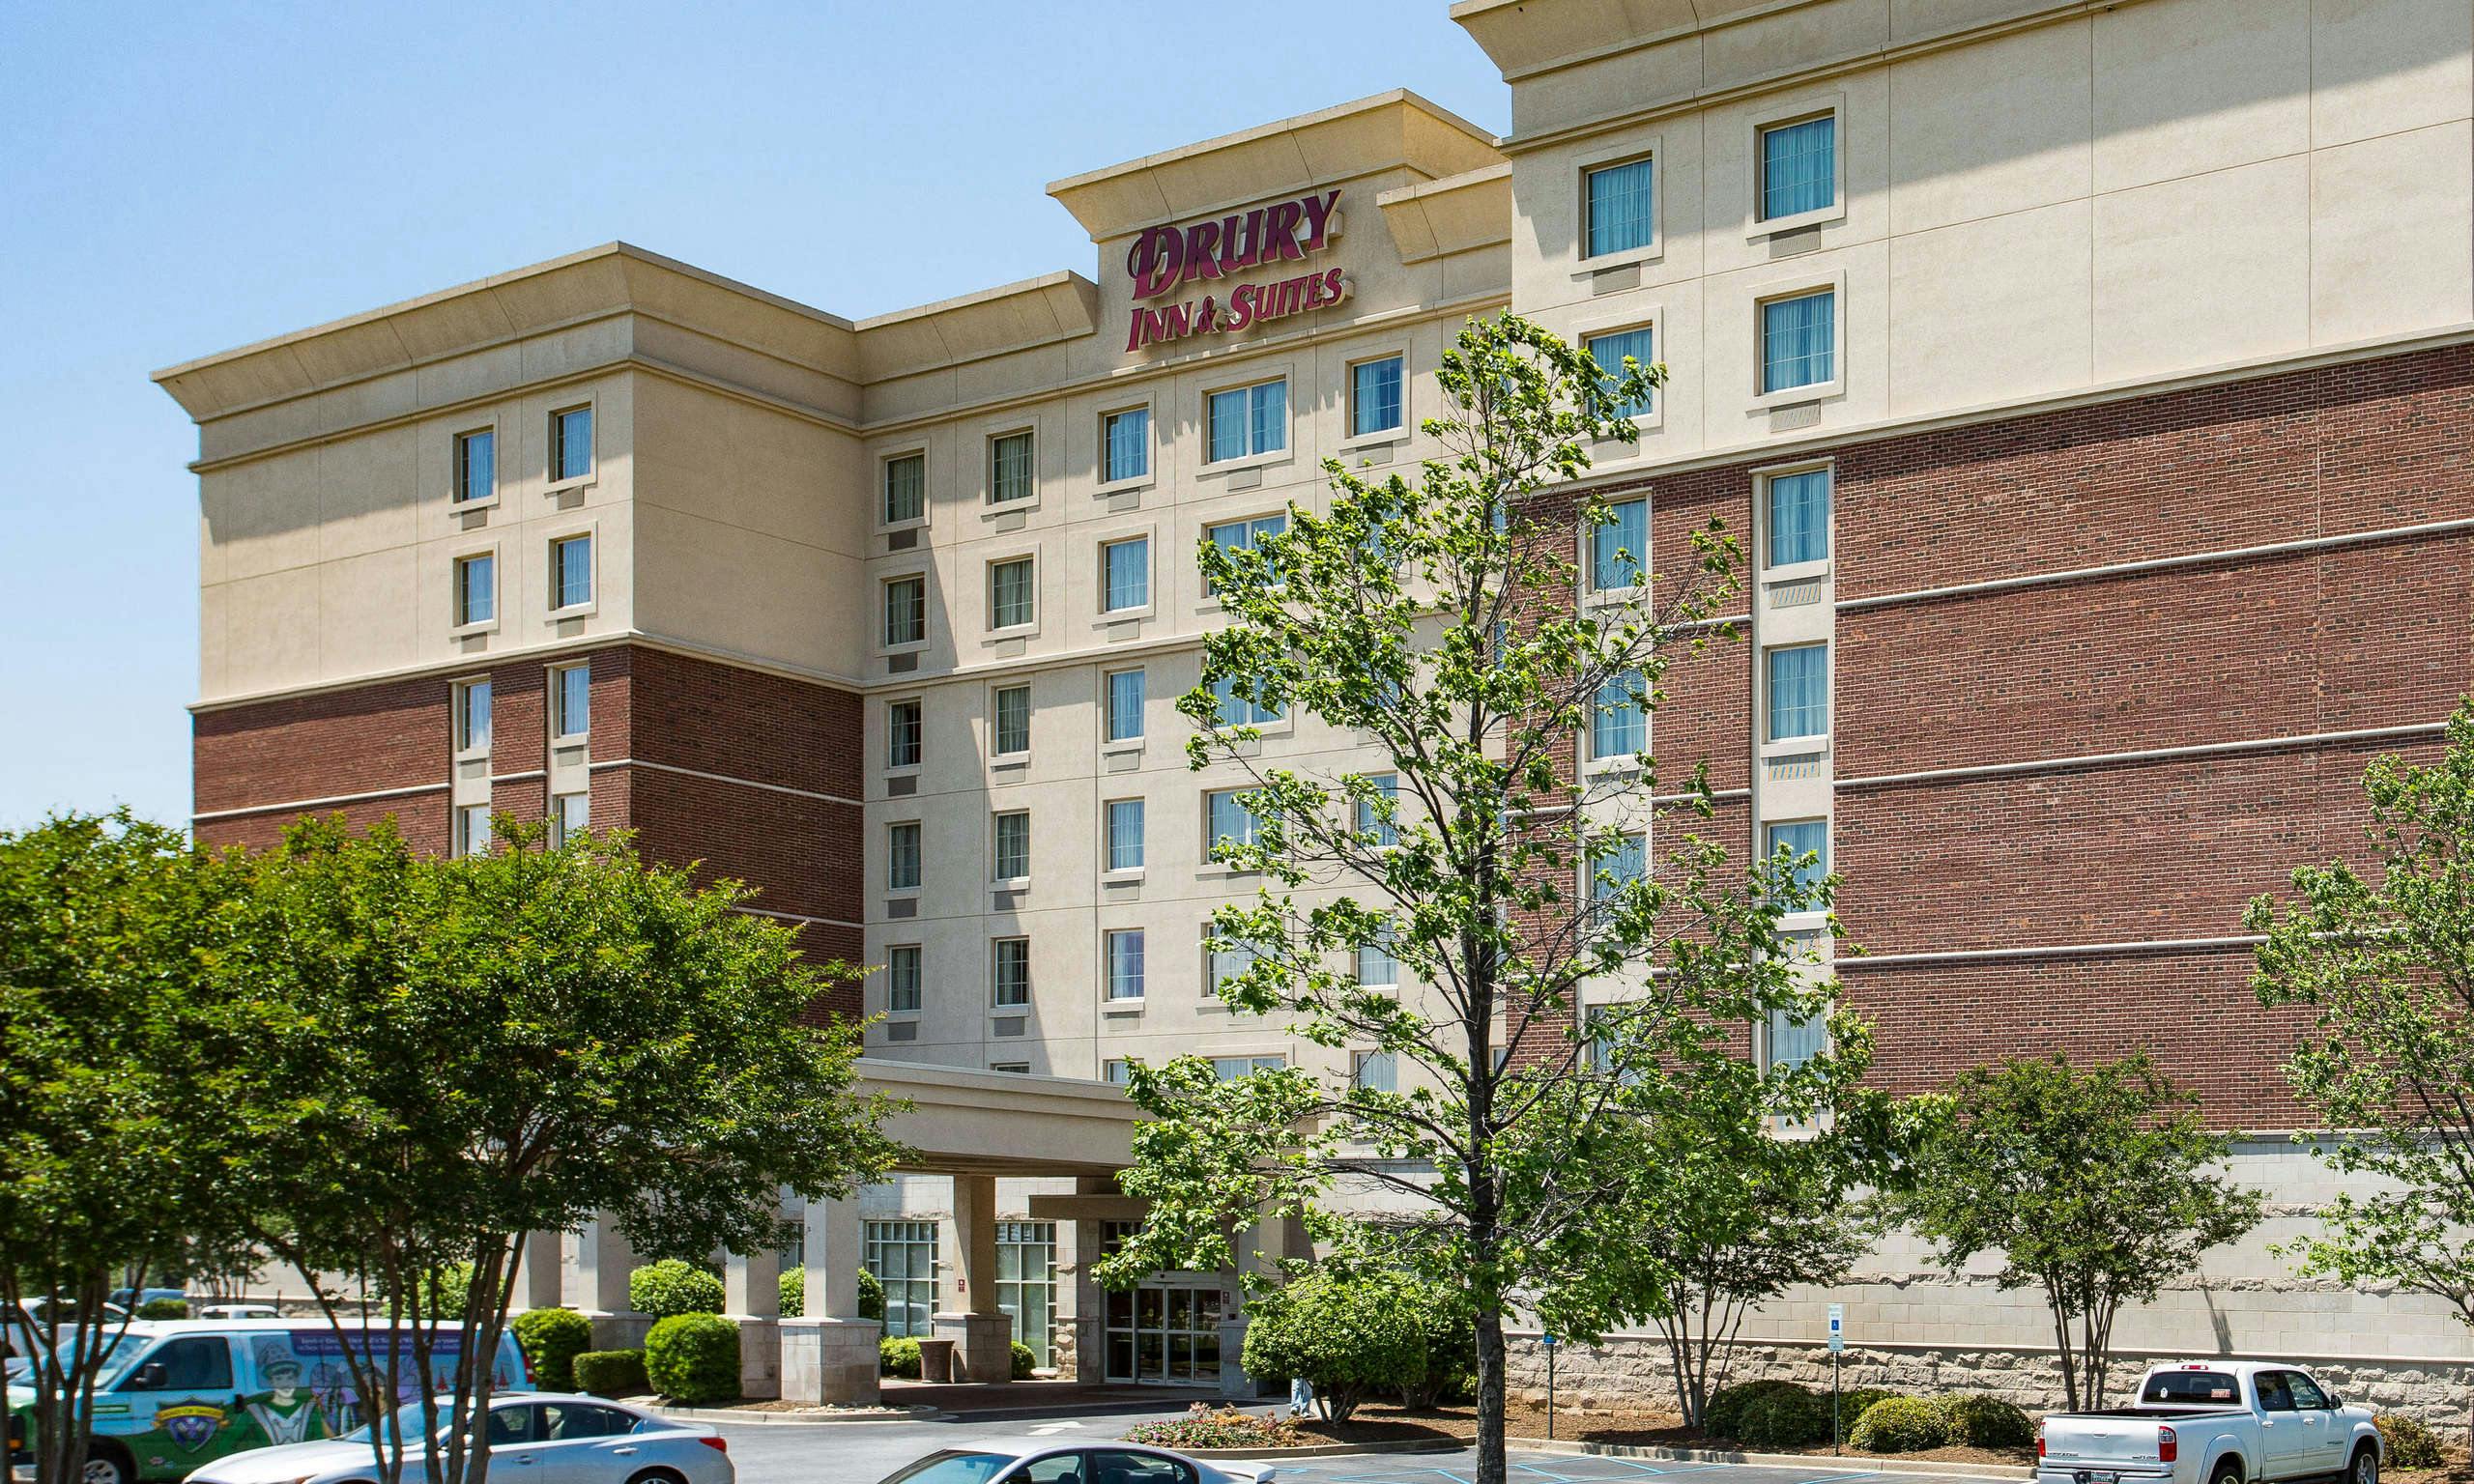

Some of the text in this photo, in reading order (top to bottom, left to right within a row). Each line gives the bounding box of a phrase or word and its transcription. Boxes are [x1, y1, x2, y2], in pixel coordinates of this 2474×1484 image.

[1127, 188, 1343, 300] DRURY
[1126, 300, 1194, 354] INN
[1226, 267, 1346, 333] SUITES
